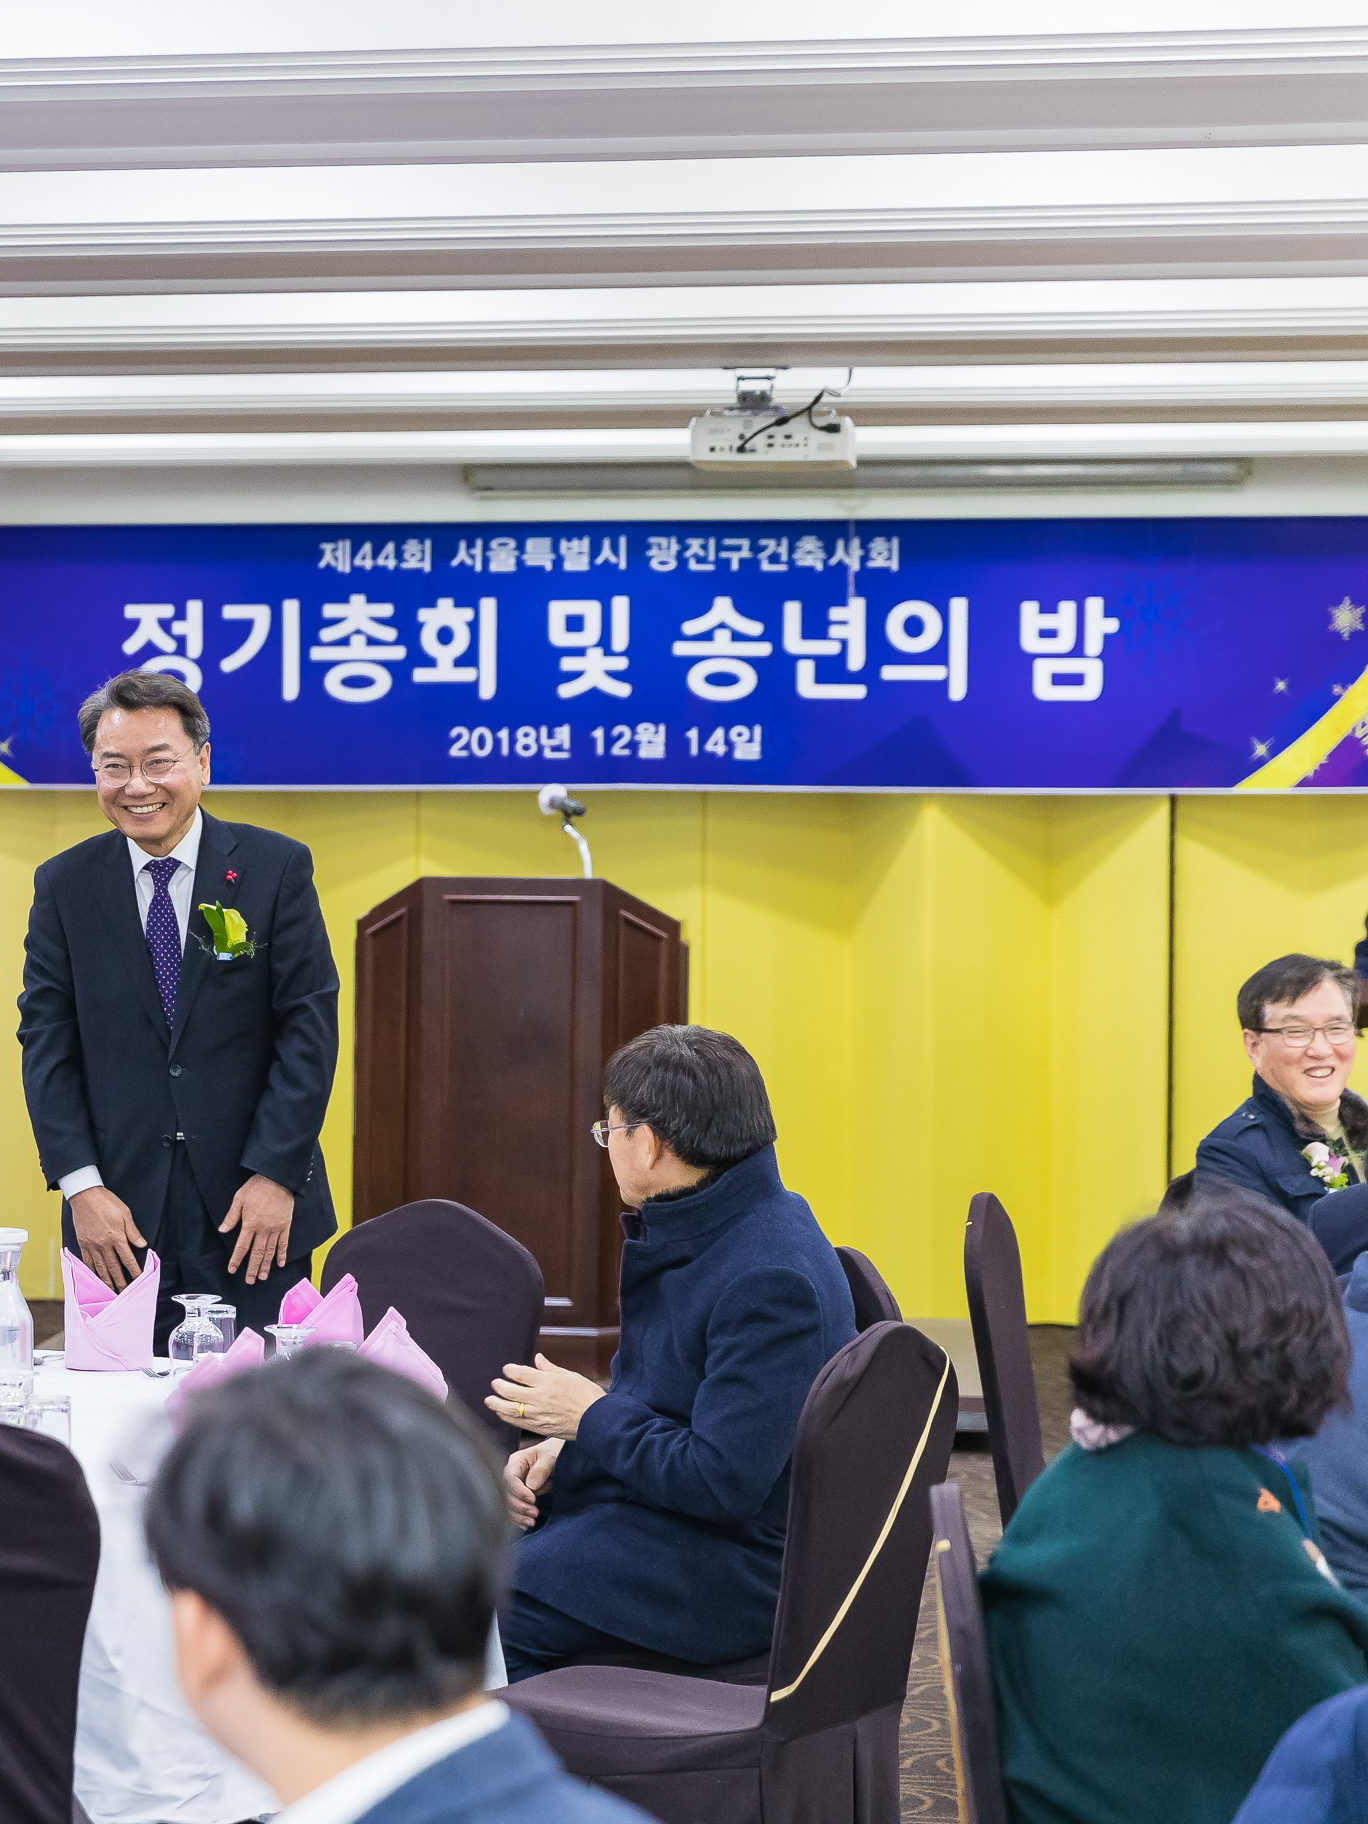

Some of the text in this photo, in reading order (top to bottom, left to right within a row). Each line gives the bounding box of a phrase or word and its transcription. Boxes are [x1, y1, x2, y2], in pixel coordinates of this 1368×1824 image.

[318, 535, 901, 575] 제44회 서울특별시 광진구건축사회
[121, 593, 1121, 704] 정기총회 및 송년의 밤
[448, 721, 764, 762] 2018년 12월 14일
